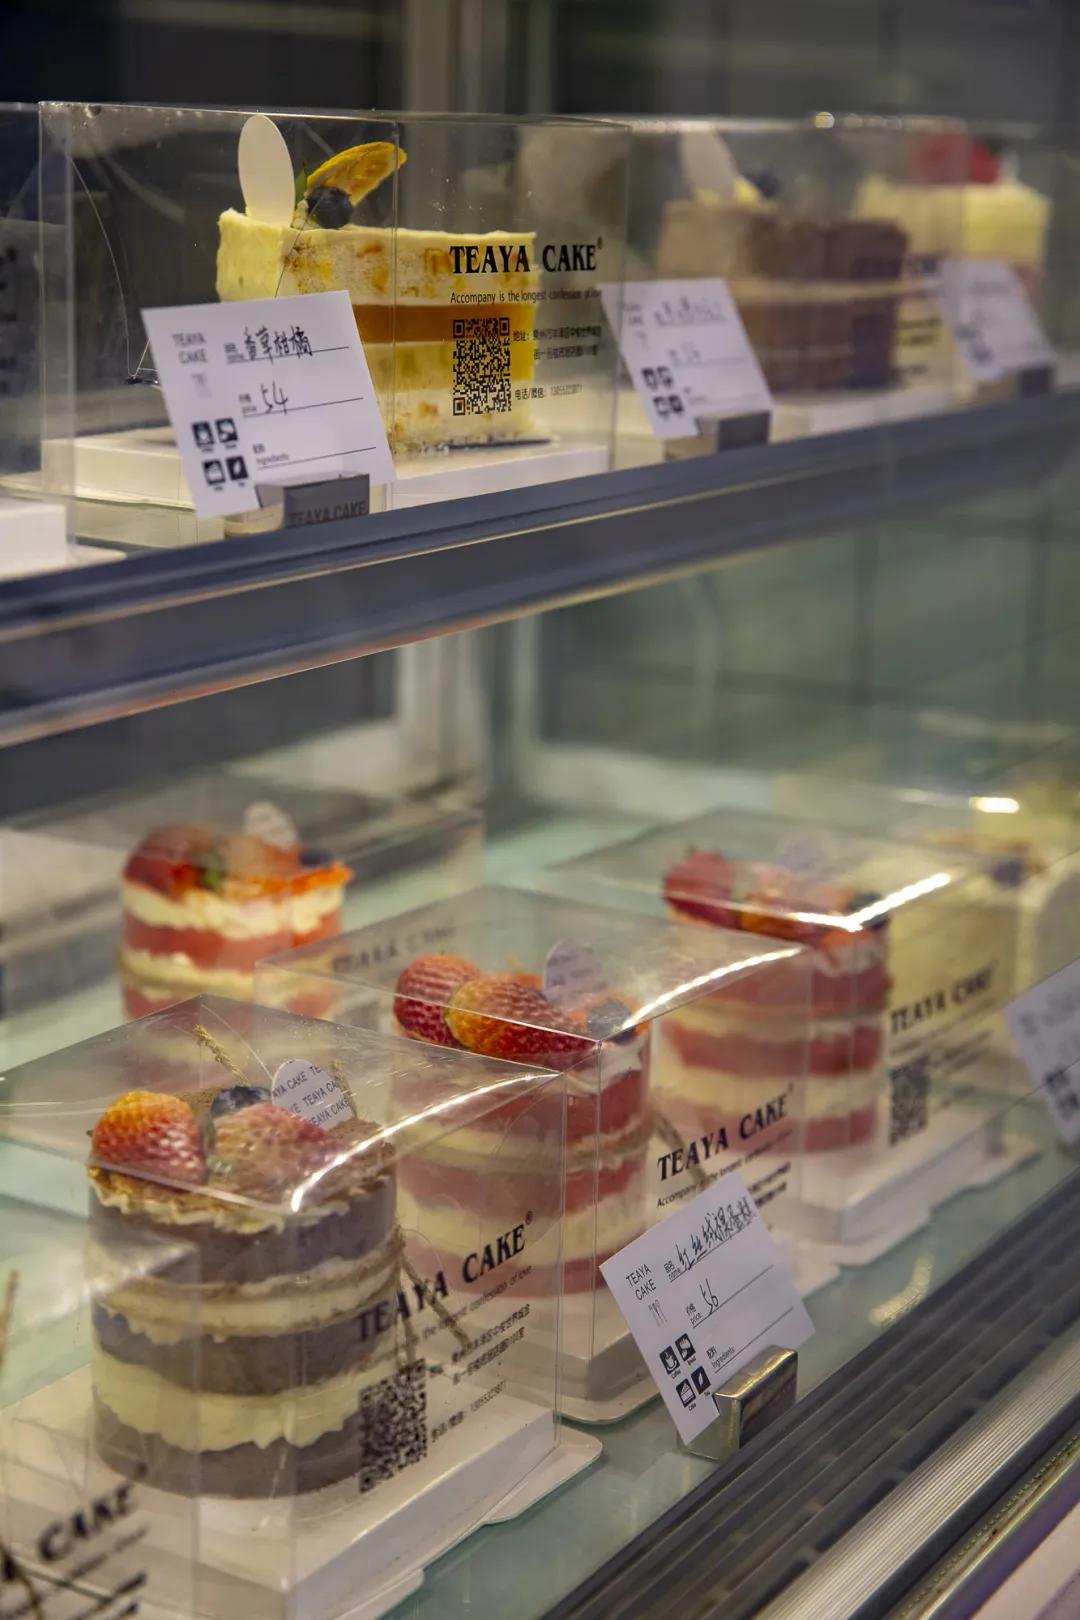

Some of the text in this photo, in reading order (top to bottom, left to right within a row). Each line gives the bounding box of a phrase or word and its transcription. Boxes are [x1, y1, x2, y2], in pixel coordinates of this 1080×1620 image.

[450, 245, 530, 274] TEAYA
[450, 291, 496, 305] Accompany
[499, 290, 505, 302] is
[508, 290, 519, 302] the
[259, 379, 288, 415] 54
[287, 1071, 308, 1090] CAKE
[302, 1087, 327, 1107] TEAYA
[657, 1127, 729, 1181] TEAYA
[462, 1224, 527, 1284] CAKE
[626, 1263, 652, 1287] TEAYA
[635, 1278, 657, 1301] CAKE
[700, 1277, 719, 1315] 56
